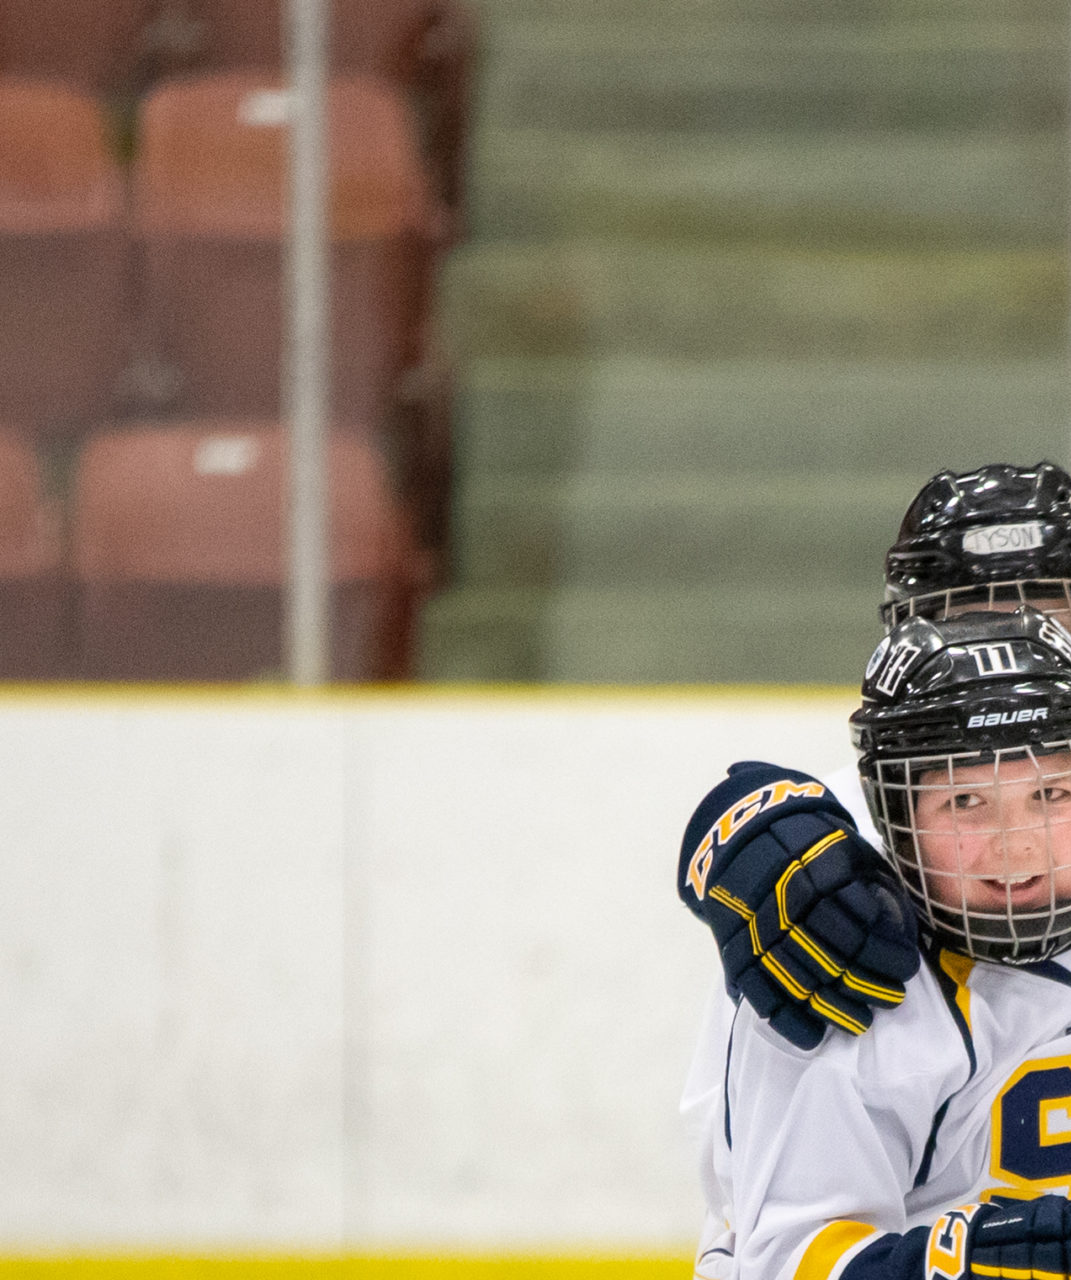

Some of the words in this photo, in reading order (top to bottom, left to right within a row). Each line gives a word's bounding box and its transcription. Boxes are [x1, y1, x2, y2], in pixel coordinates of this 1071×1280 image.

[966, 526, 1036, 551] TYSON
[968, 643, 1017, 676] 11
[967, 706, 1050, 729] BAUER
[685, 779, 825, 900] CCM
